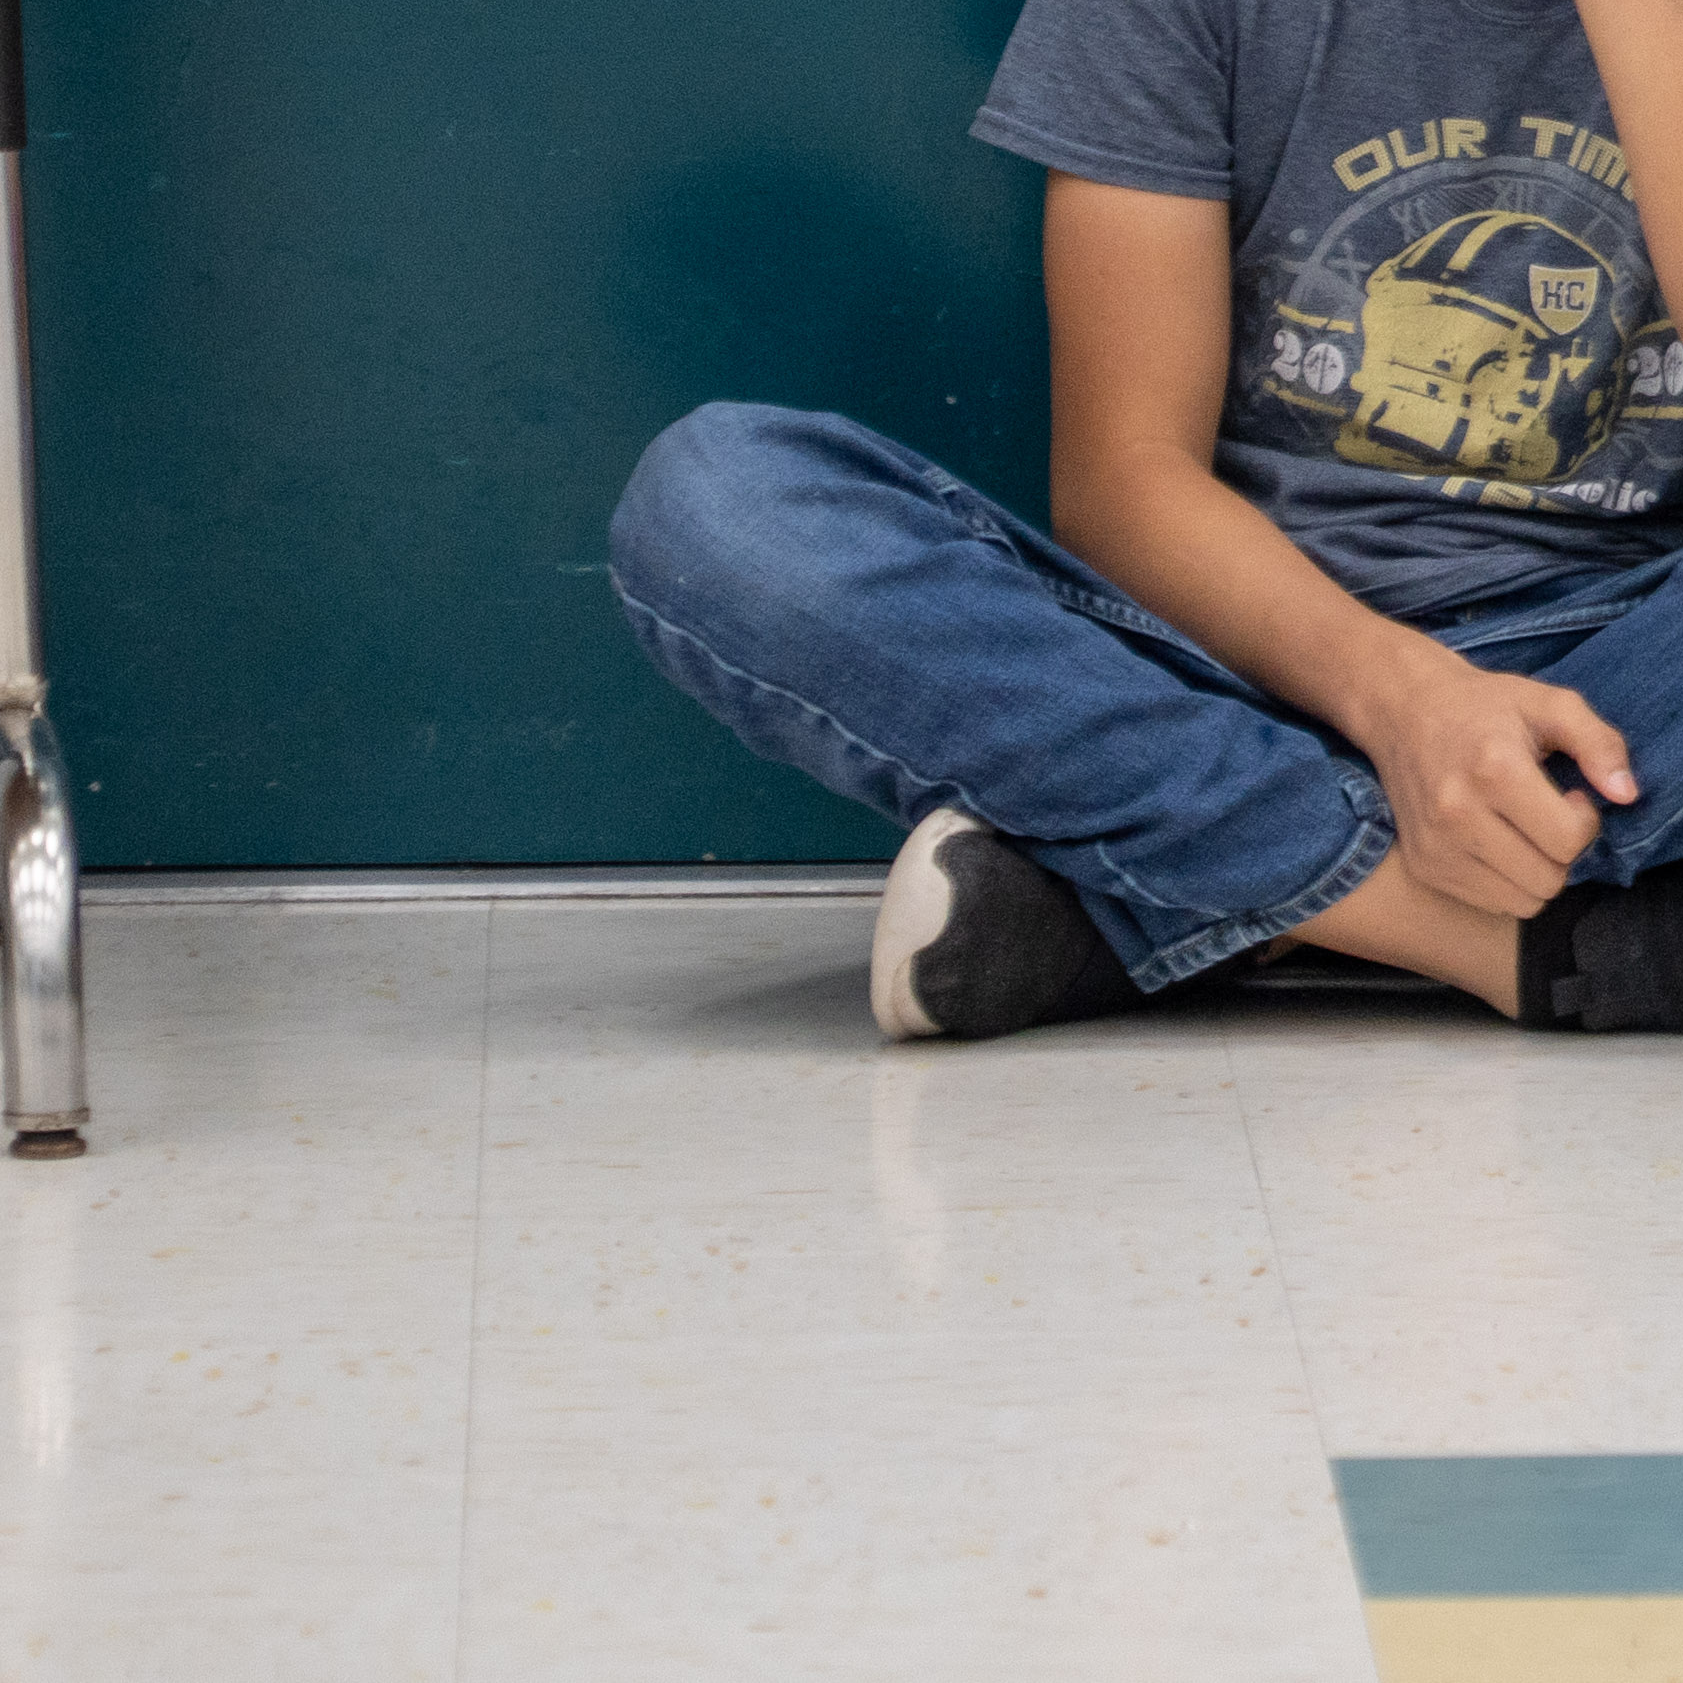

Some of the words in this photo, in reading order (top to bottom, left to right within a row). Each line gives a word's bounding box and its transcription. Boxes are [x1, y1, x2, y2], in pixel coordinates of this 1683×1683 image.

[1333, 117, 1488, 192] OUR
[1520, 116, 1635, 201] TIM
[1541, 281, 1585, 312] HC
[1270, 329, 1346, 395] 20
